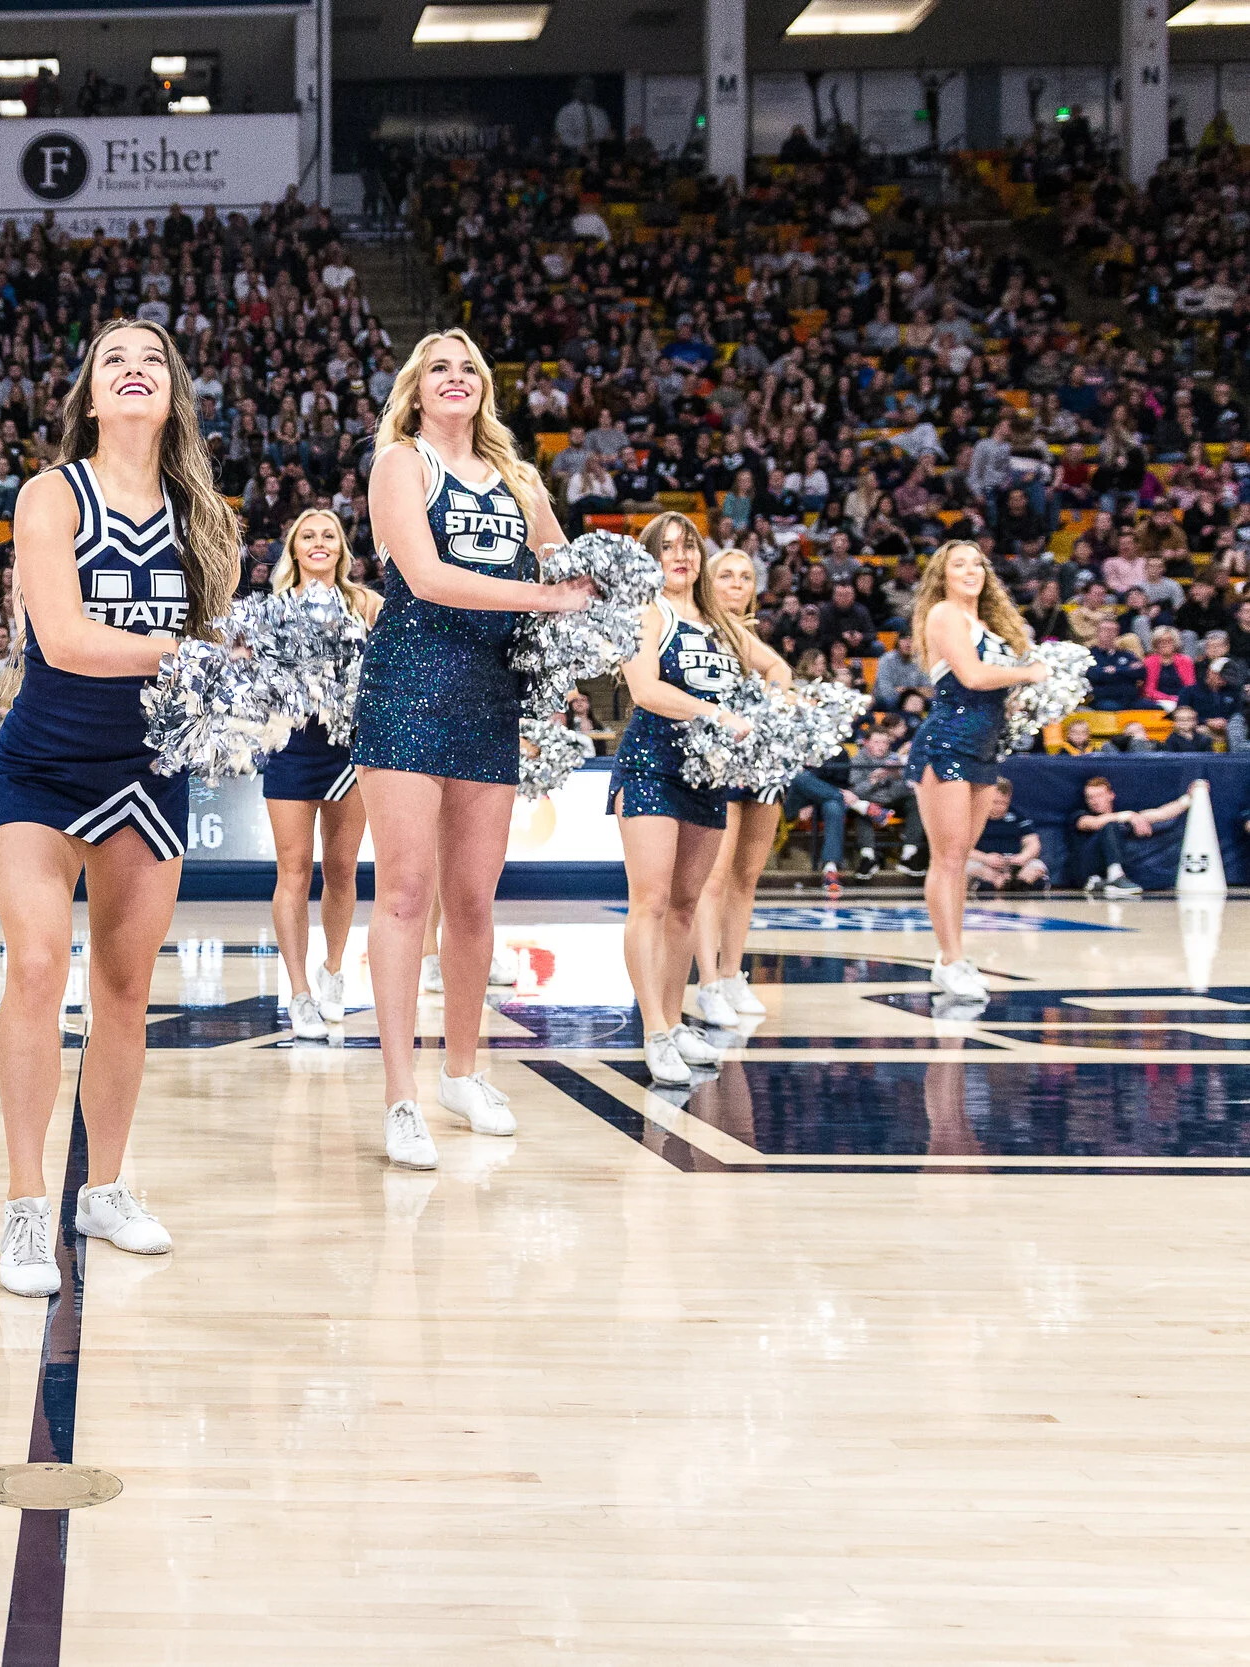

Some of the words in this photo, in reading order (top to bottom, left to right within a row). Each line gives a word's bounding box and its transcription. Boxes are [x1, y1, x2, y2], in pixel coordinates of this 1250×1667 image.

[717, 74, 737, 92] M
[39, 146, 72, 189] F
[102, 135, 220, 174] Fisher
[98, 177, 141, 191] Home
[144, 175, 227, 192] Furnishings
[445, 511, 525, 543] STATE
[83, 601, 190, 629] STATE
[677, 651, 740, 675] STATE
